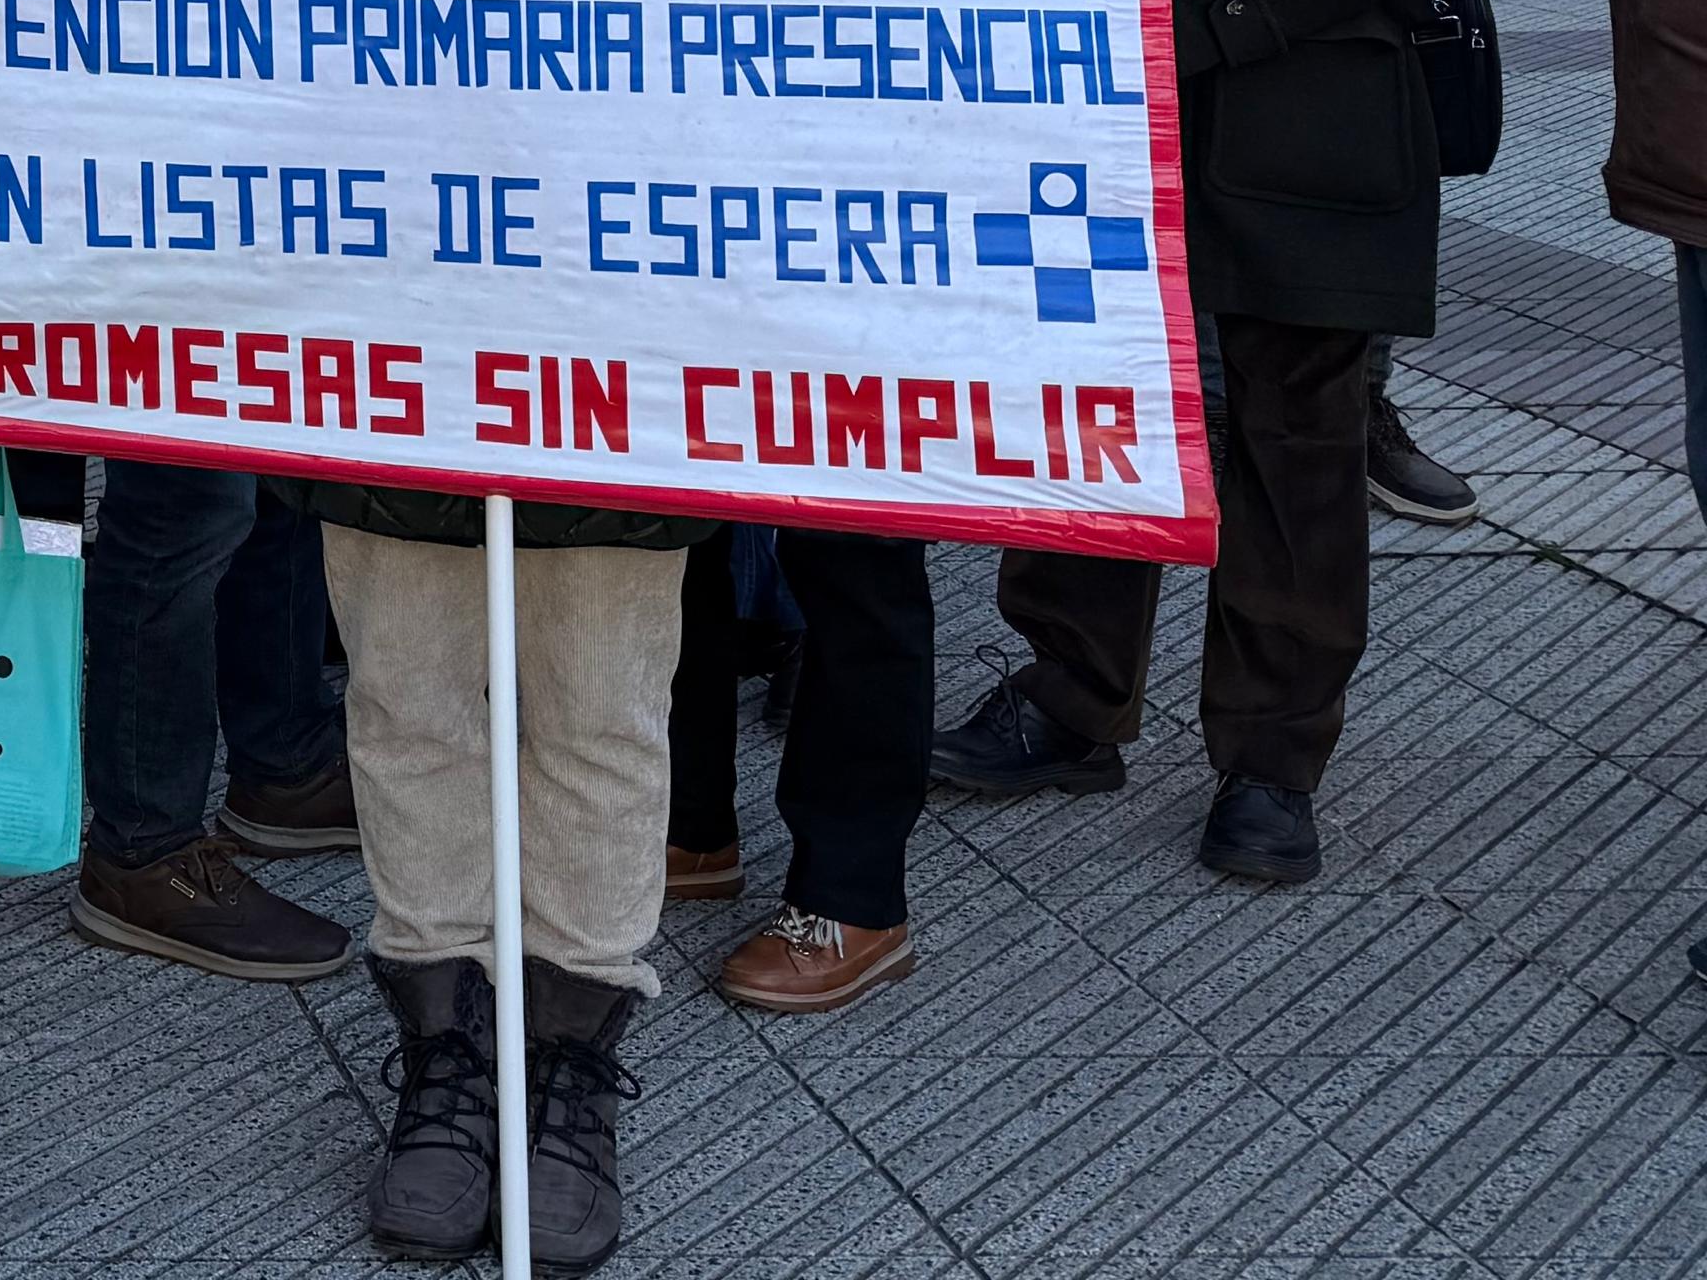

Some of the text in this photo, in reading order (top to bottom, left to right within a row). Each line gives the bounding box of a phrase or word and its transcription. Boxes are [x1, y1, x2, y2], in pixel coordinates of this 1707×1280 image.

[669, 3, 1145, 105] PRESENCIAL
[83, 158, 388, 258] LISTAS
[431, 173, 542, 268] DE
[587, 181, 951, 286] ESPERA
[476, 351, 629, 453] SIN
[683, 367, 1138, 483] CUMPLIR
